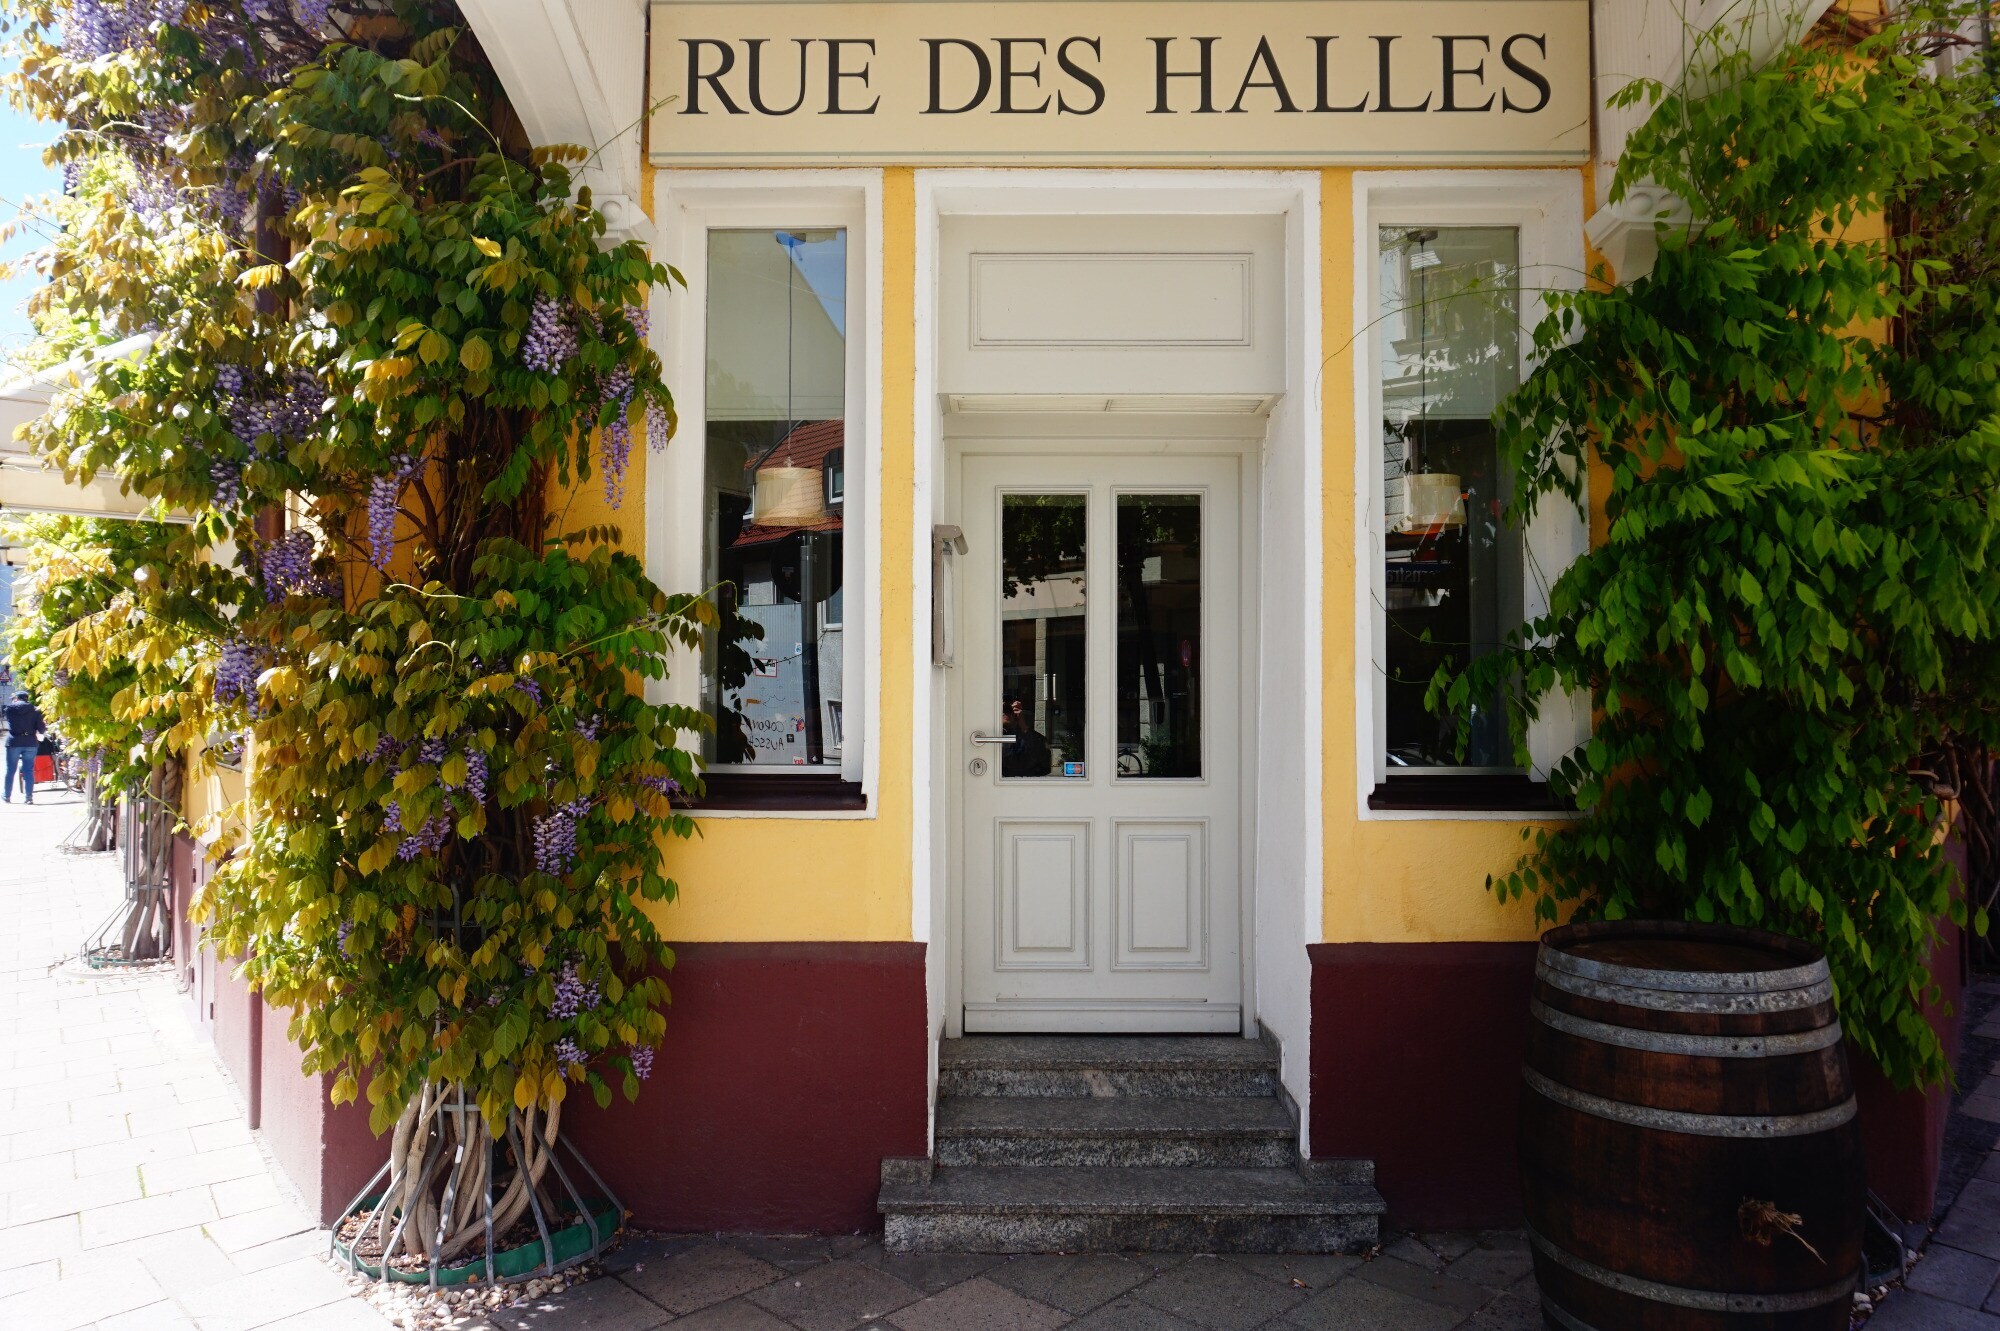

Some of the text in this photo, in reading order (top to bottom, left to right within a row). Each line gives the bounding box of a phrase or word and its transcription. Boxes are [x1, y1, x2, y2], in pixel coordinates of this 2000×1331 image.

[676, 34, 1552, 116] RUE DES HALLES
